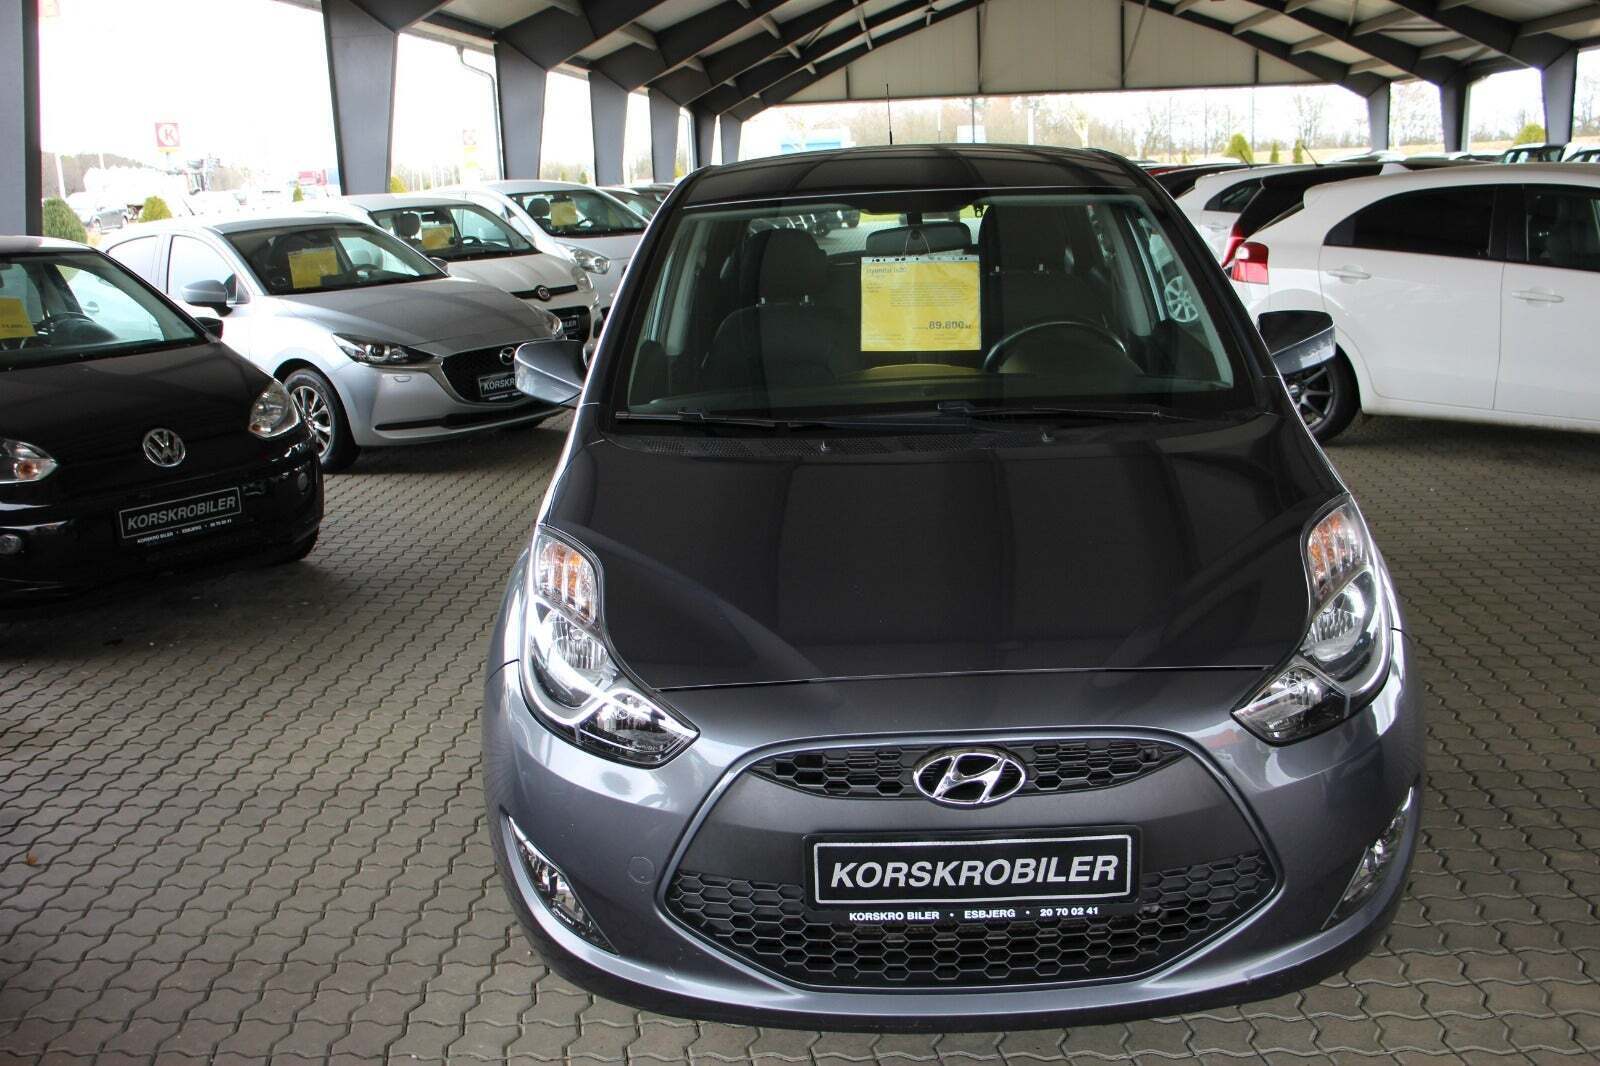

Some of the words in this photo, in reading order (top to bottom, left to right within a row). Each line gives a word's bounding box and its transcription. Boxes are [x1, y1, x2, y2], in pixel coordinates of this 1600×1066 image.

[127, 496, 236, 530] KORSKROBILER
[830, 854, 1119, 888] KORSKROBILER
[849, 911, 904, 921] KORSKRO
[906, 910, 940, 921] BILER
[964, 909, 1016, 919] ESBJERG
[1040, 908, 1054, 917] 20
[1055, 907, 1070, 917] 70
[1071, 907, 1085, 916] 02
[1086, 906, 1099, 916] 41
